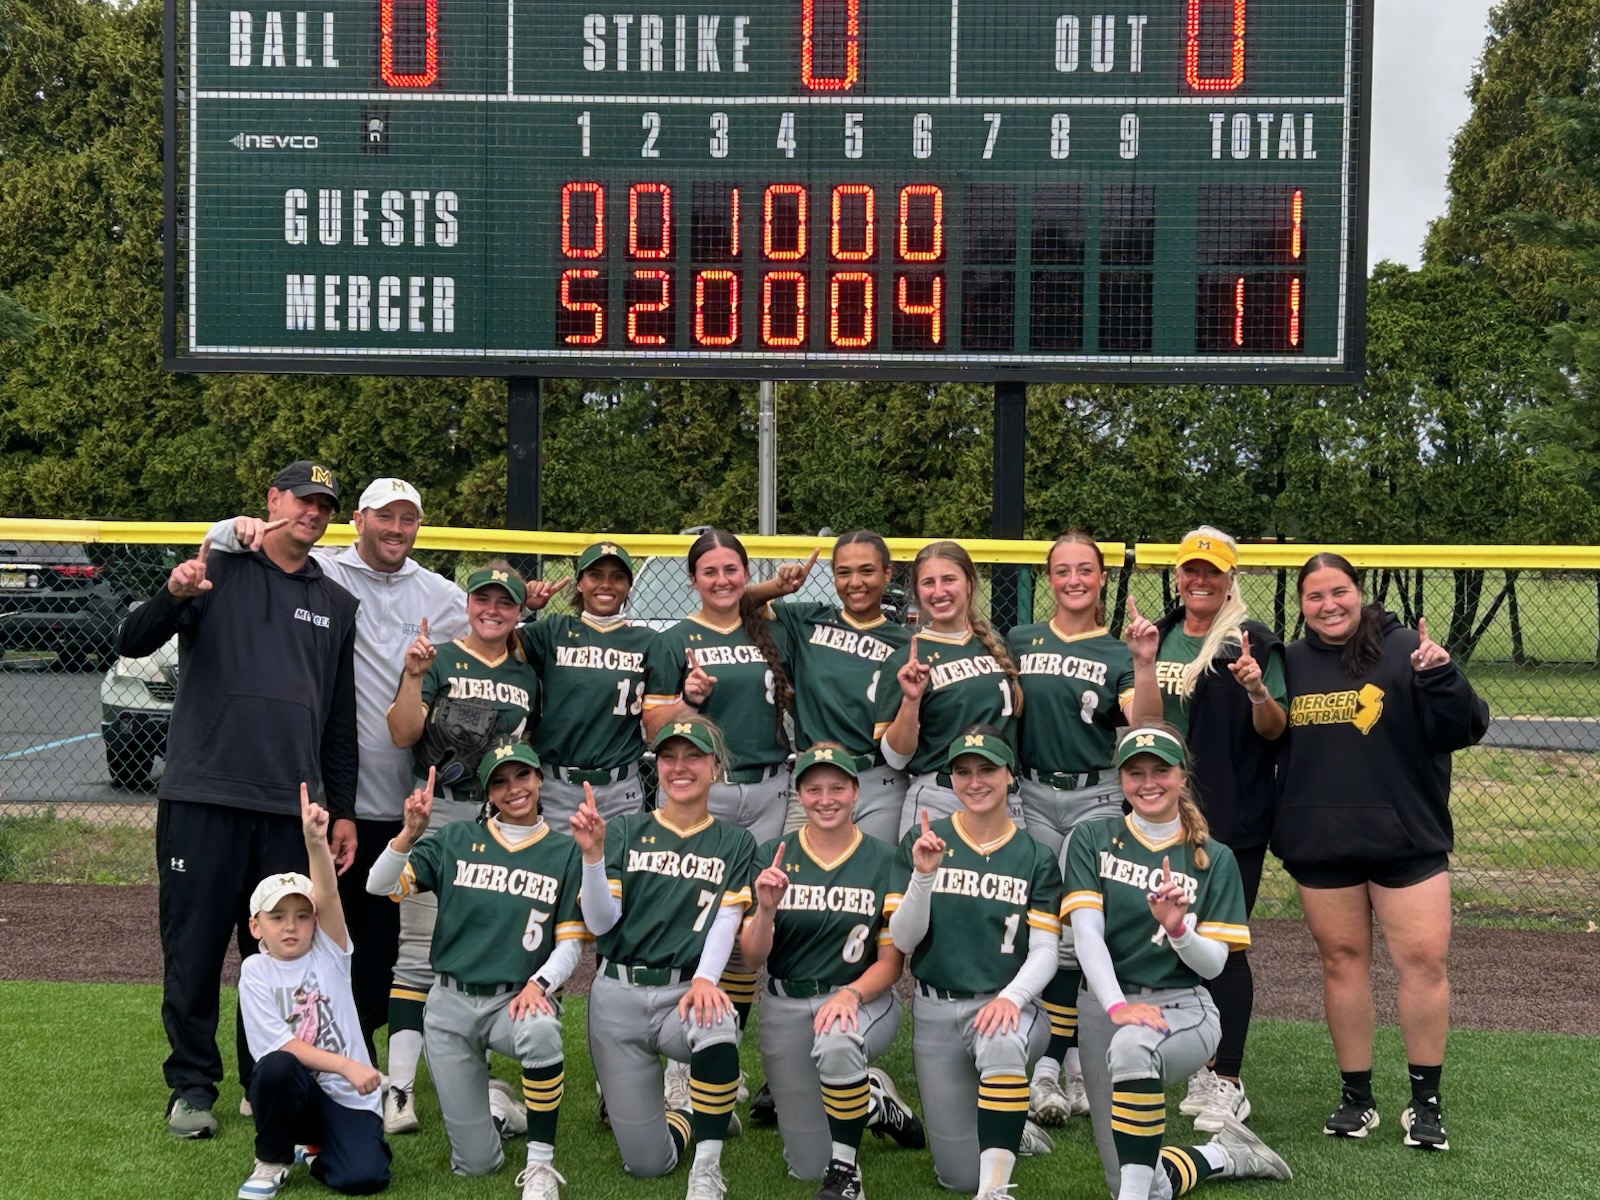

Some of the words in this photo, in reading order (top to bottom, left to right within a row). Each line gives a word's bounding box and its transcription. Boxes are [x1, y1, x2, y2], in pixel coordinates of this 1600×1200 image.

[229, 11, 340, 68] BALL
[381, 0, 438, 88] 0
[583, 14, 750, 73] STRIKE
[801, 0, 859, 91] 0
[1055, 15, 1148, 73] OUT
[1186, 0, 1246, 91] 0
[244, 135, 319, 149] NEVCO
[577, 111, 591, 157] 1
[641, 112, 661, 158] 2
[709, 112, 729, 158] 3
[776, 112, 797, 158] 4
[845, 113, 864, 159] 5
[913, 113, 932, 159] 6
[982, 113, 1001, 159] 7
[1050, 113, 1070, 159] 8
[1119, 113, 1140, 159] 9
[1209, 113, 1317, 159] TOTAL
[284, 188, 459, 248] GUESTS
[561, 182, 604, 258] 0
[629, 183, 671, 259] 0
[730, 190, 740, 256] 1
[763, 184, 807, 260] 0
[831, 185, 874, 261] 0
[899, 185, 943, 261] 0
[1292, 191, 1302, 258] 1
[286, 274, 456, 333] MERCER
[561, 269, 603, 344] 5
[627, 270, 670, 345] 2
[695, 270, 738, 346] 0
[762, 271, 806, 346] 0
[830, 272, 873, 347] 0
[898, 276, 942, 344] 4
[1234, 279, 1300, 346] 11
[311, 466, 333, 489] M
[391, 480, 406, 492] M
[1197, 540, 1211, 550] M
[491, 569, 508, 582] M
[555, 646, 645, 673] MERCER
[684, 645, 768, 668] MERCE
[1018, 653, 1108, 687] MERCER
[929, 655, 1005, 690] MERCE
[447, 677, 530, 711] MERCER
[1290, 690, 1359, 712] MERCER
[673, 722, 692, 735] M
[964, 734, 984, 747] M
[1135, 734, 1155, 748] M
[494, 744, 514, 760] M
[813, 749, 834, 761] M
[627, 849, 726, 885] MERCER
[452, 860, 559, 905] MERCER
[692, 890, 719, 932] 7
[521, 908, 551, 952] 5
[841, 923, 870, 964] 6
[1000, 913, 1021, 954] 1
